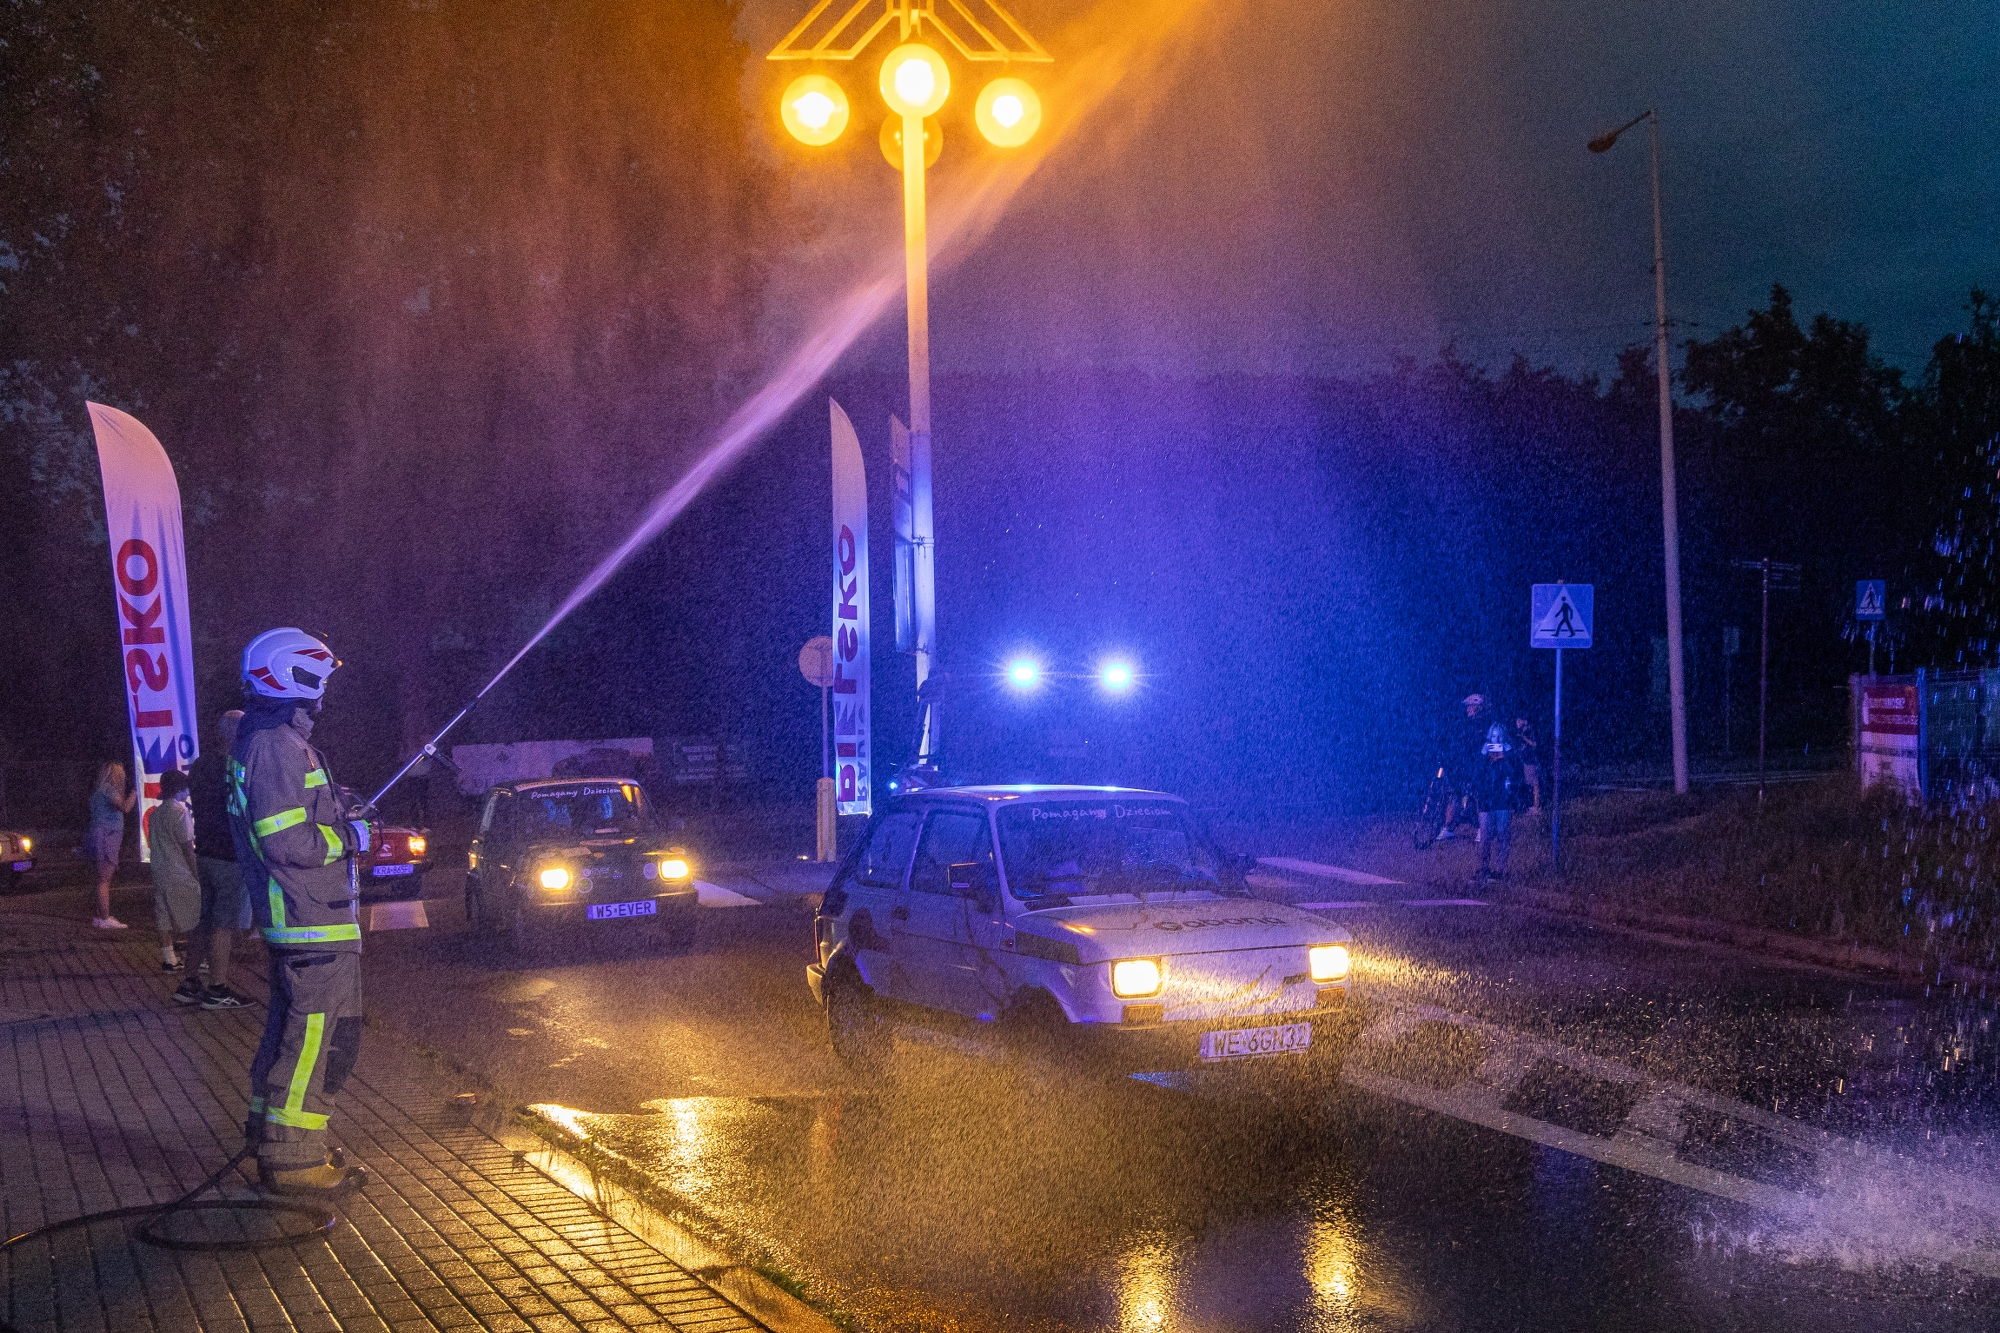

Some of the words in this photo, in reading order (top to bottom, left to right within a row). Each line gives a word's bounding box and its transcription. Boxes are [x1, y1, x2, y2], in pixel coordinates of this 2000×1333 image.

[531, 790, 578, 799] Pomagamy
[583, 787, 621, 796] Dzieciom
[1113, 804, 1172, 819] Dzieciom
[618, 901, 652, 916] EVER
[1214, 1031, 1240, 1055] WE
[1248, 1024, 1307, 1052] 6GN32
